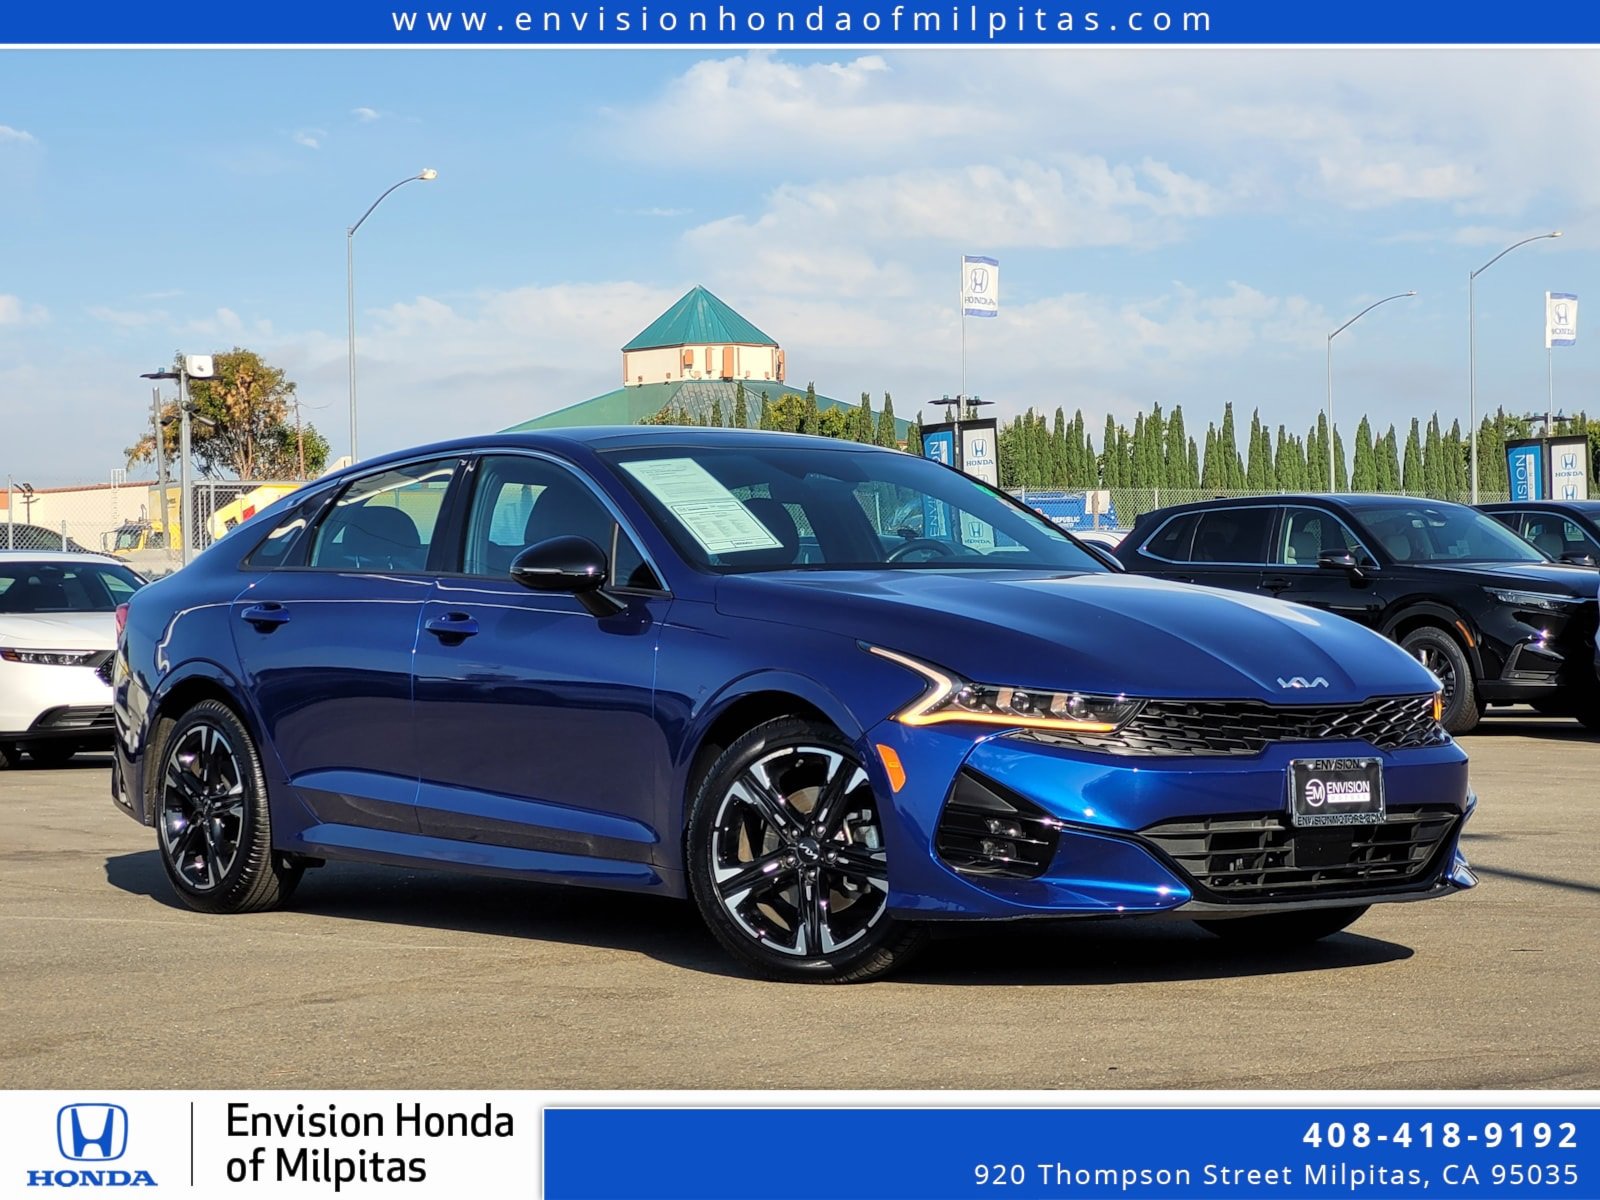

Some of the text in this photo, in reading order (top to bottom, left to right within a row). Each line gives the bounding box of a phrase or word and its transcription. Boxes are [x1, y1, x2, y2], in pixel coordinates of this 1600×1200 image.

[966, 459, 994, 467] HONDA
[1554, 470, 1584, 478] HONDA
[1315, 759, 1360, 770] ENVISION
[1326, 781, 1370, 794] ENVISION
